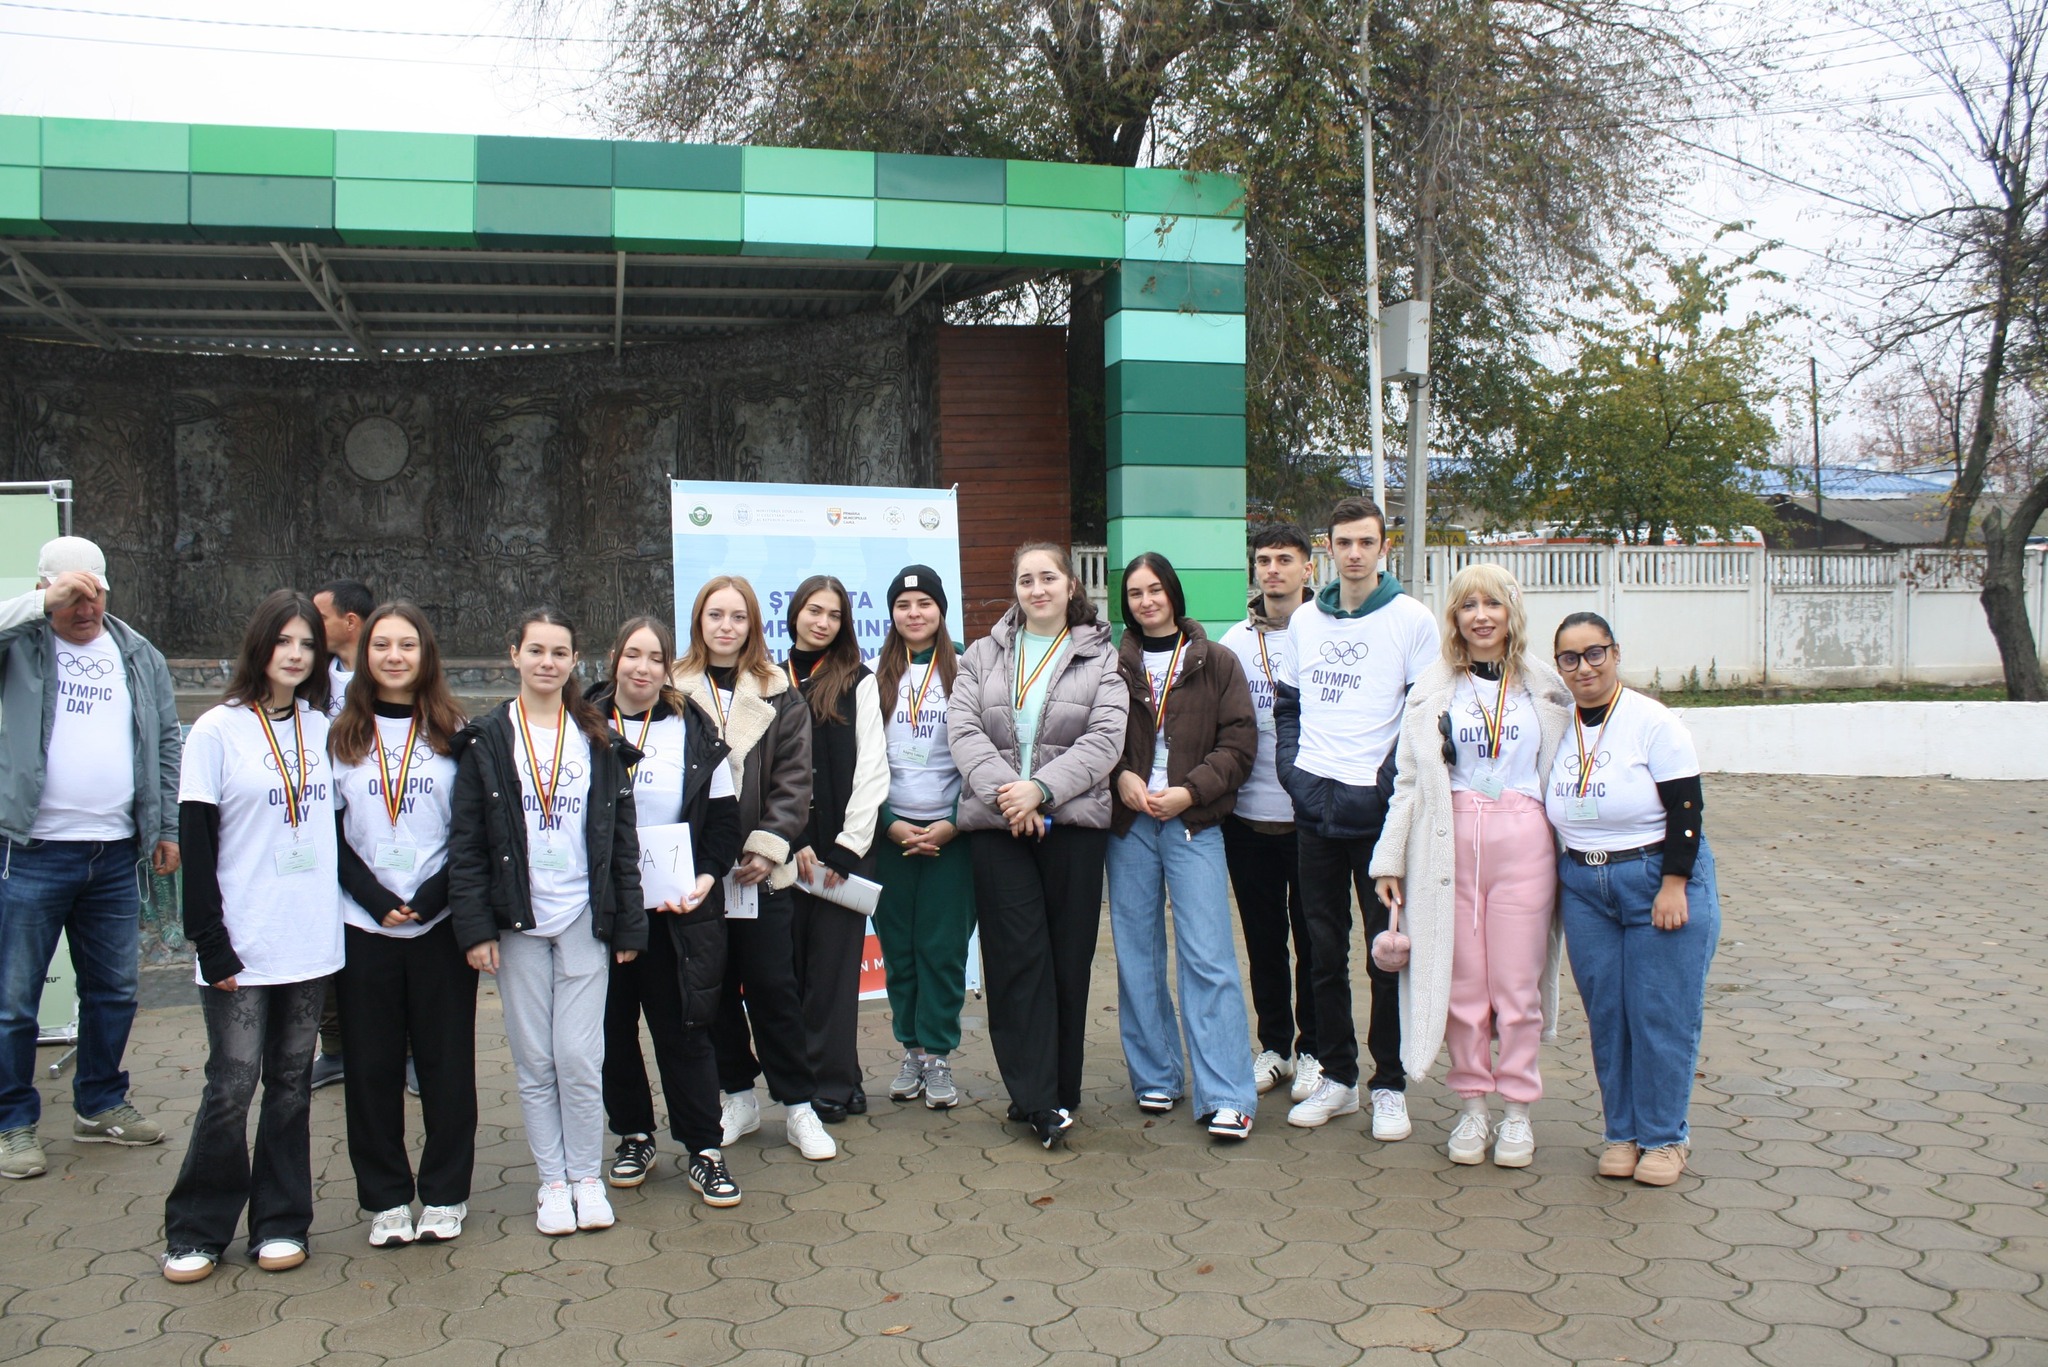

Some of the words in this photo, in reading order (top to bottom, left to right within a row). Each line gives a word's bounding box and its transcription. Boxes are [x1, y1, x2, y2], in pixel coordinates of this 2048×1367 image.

[1311, 669, 1362, 690] OLYMPIC
[1320, 687, 1344, 704] DAY
[66, 698, 94, 715] DAY
[896, 709, 948, 725] OLMPIC
[394, 796, 416, 814] AY
[639, 848, 656, 872] A
